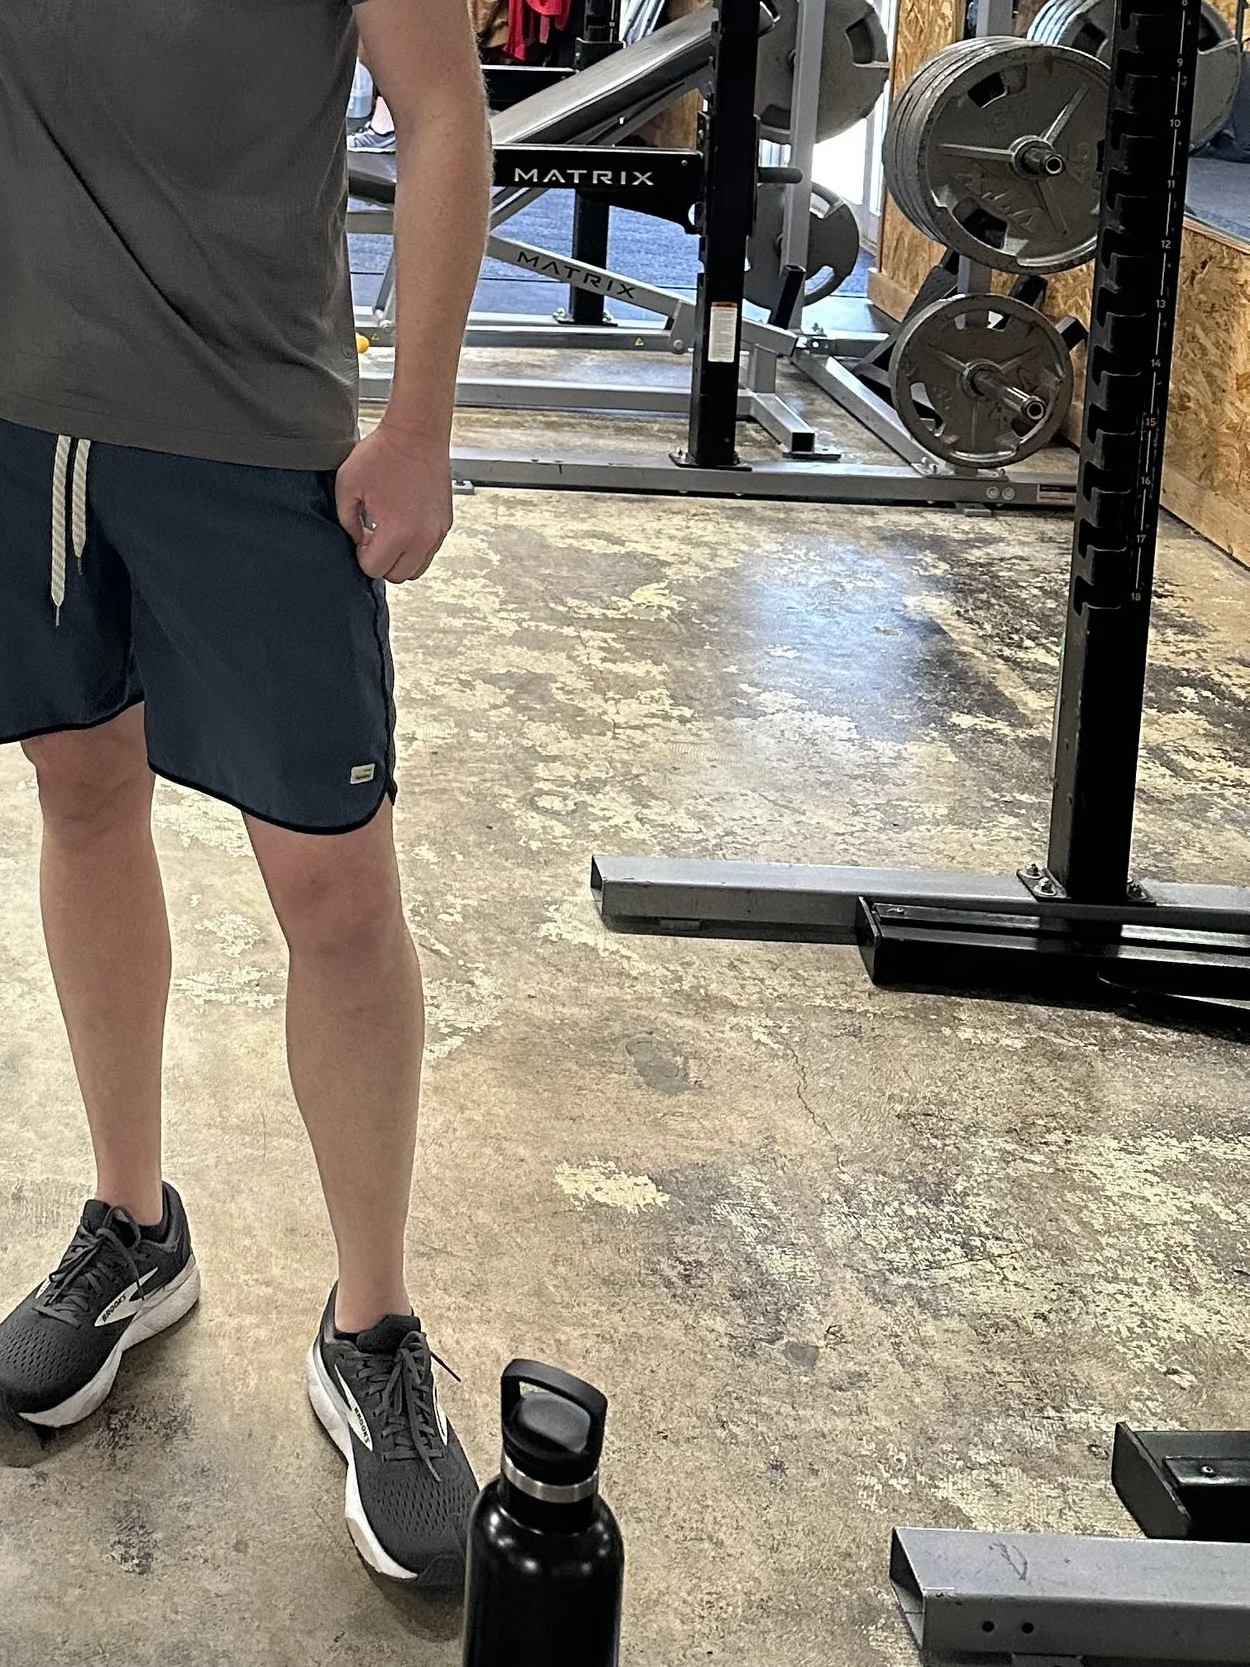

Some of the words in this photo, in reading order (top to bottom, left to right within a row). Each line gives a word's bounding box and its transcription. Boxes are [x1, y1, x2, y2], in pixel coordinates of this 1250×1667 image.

[1176, 57, 1184, 67] 9
[1170, 118, 1181, 128] 10
[513, 167, 655, 186] MATRIX
[1166, 179, 1176, 189] 11
[1161, 239, 1171, 249] 12
[517, 251, 636, 300] MATRIX
[1155, 299, 1166, 309] 13
[1150, 358, 1161, 368] 14
[1145, 417, 1156, 427] 15
[1141, 476, 1151, 486] 16
[1136, 534, 1147, 544] 17
